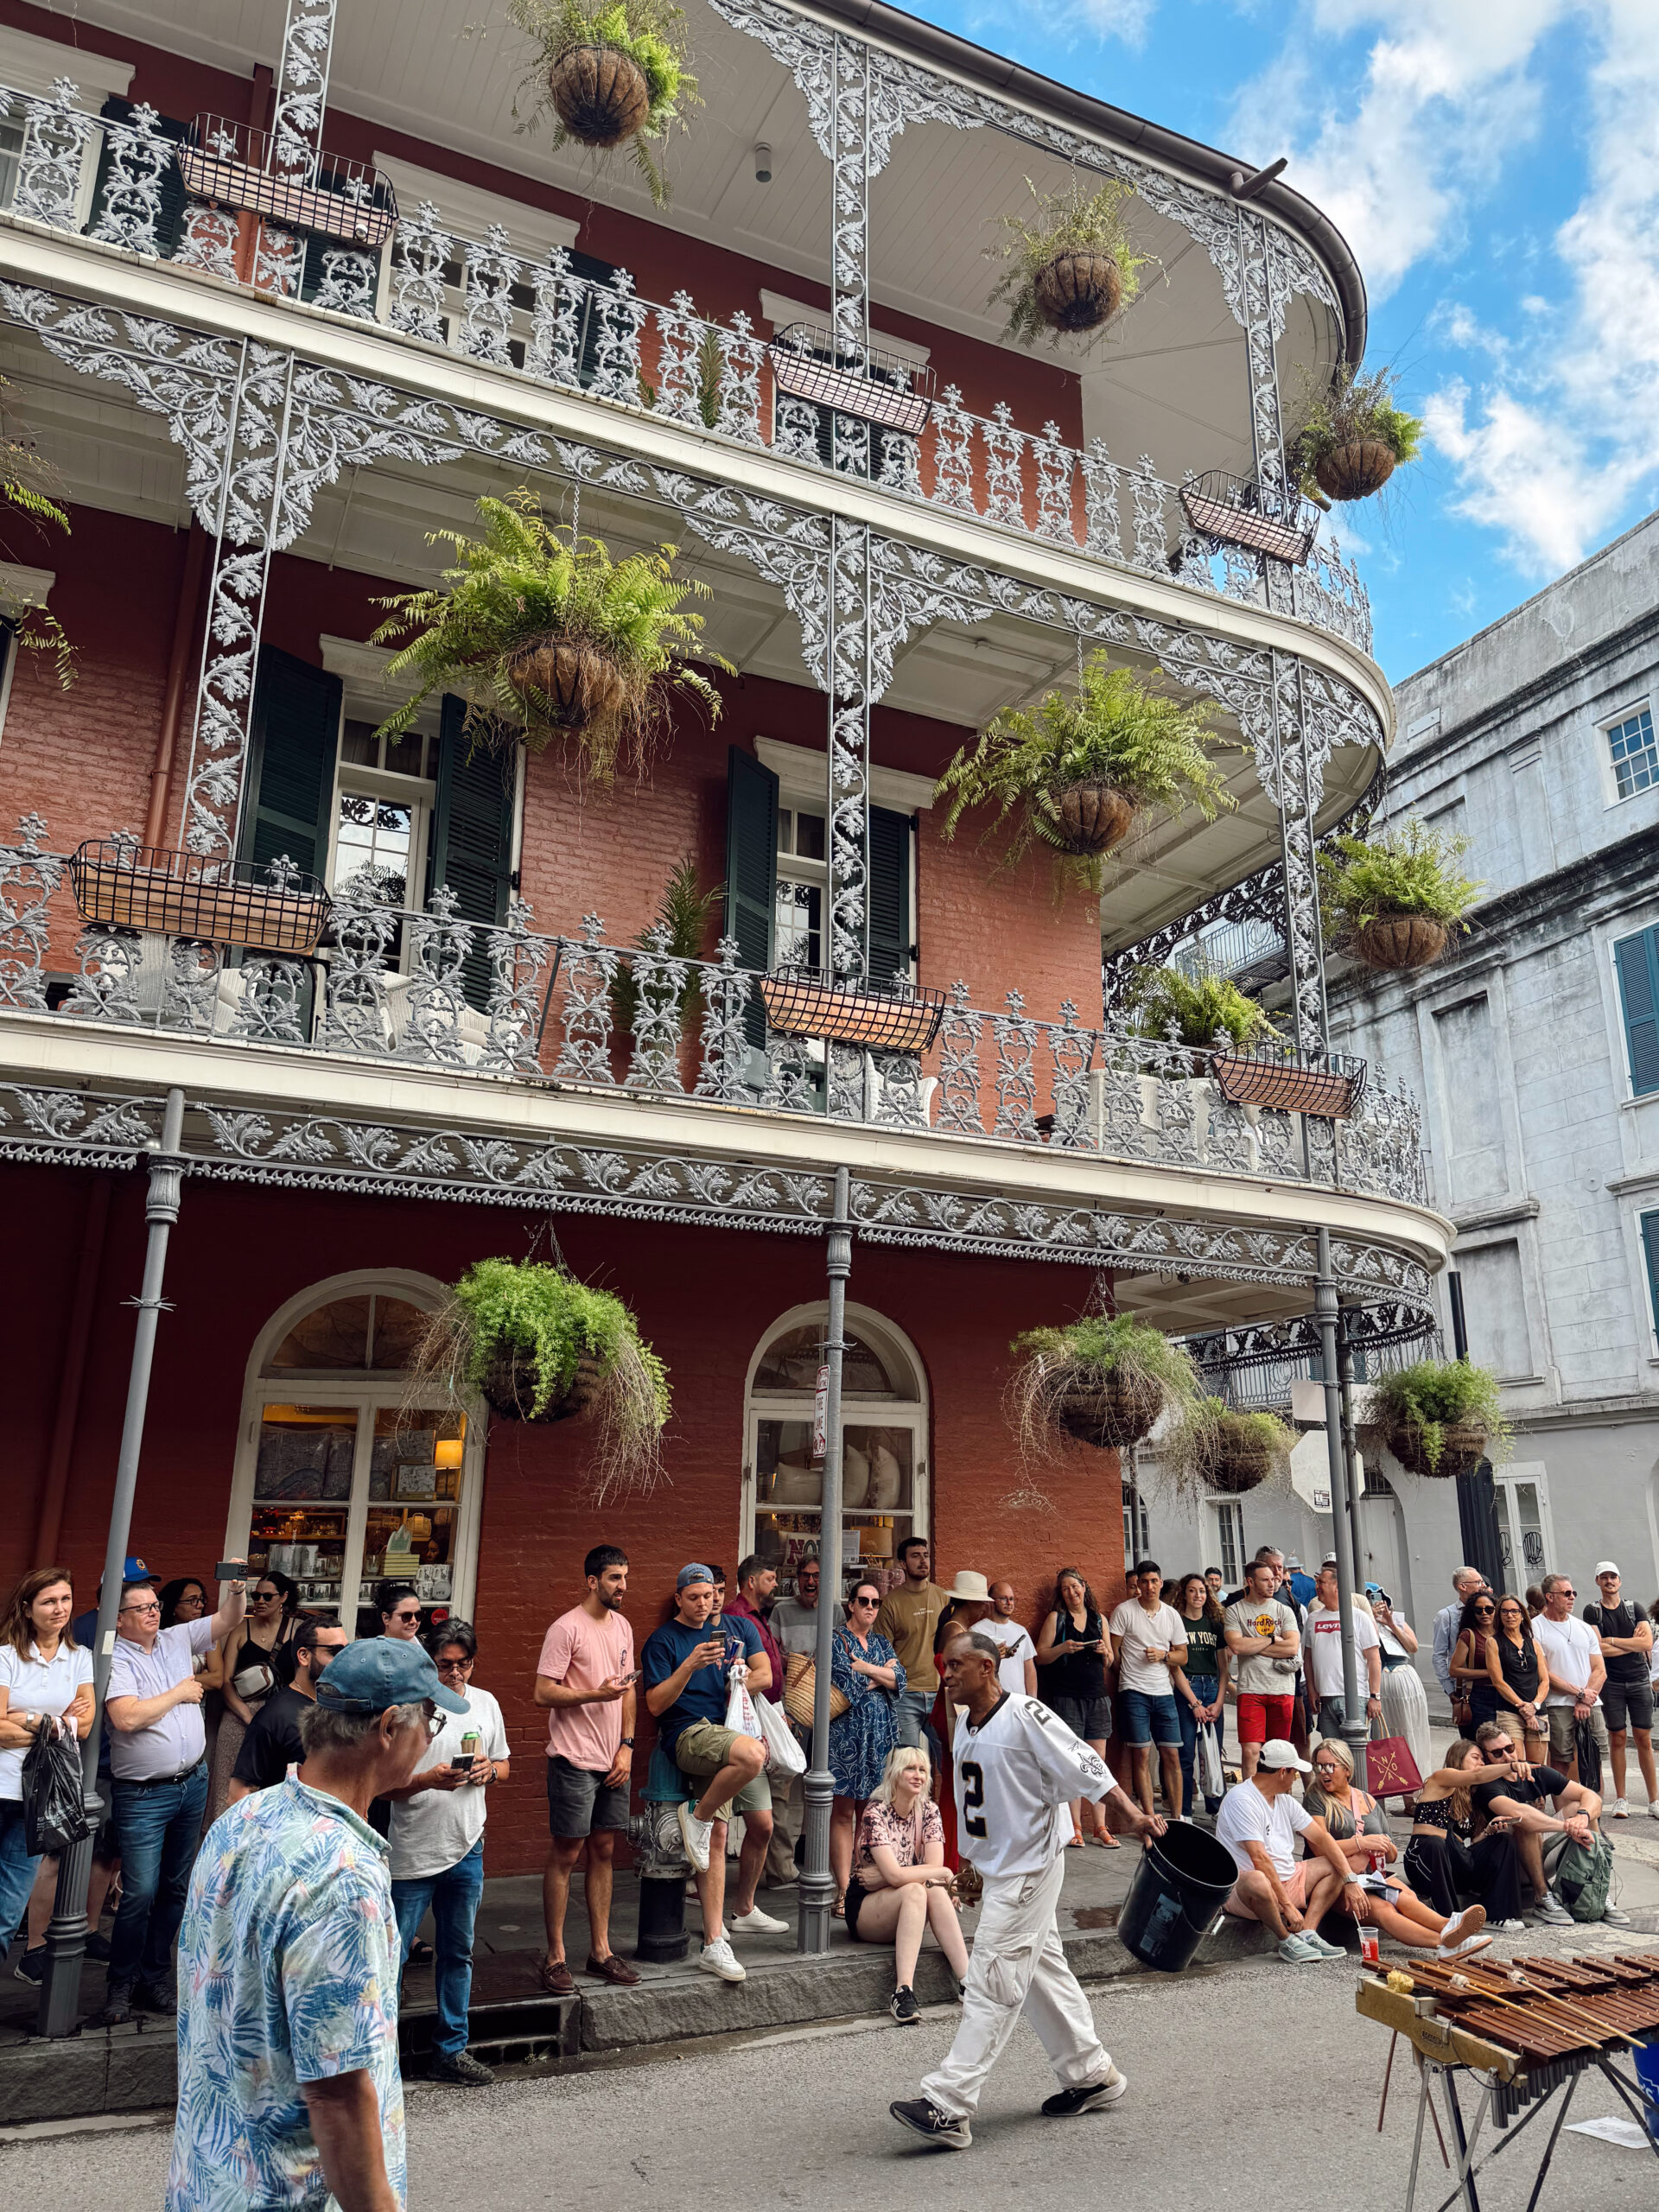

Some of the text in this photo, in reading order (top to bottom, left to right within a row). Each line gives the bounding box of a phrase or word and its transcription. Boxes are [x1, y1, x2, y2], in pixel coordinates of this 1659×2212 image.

[1247, 1618, 1282, 1628] Hard Rock
[1024, 1700, 1052, 1725] 2
[961, 1761, 988, 1840] 2
